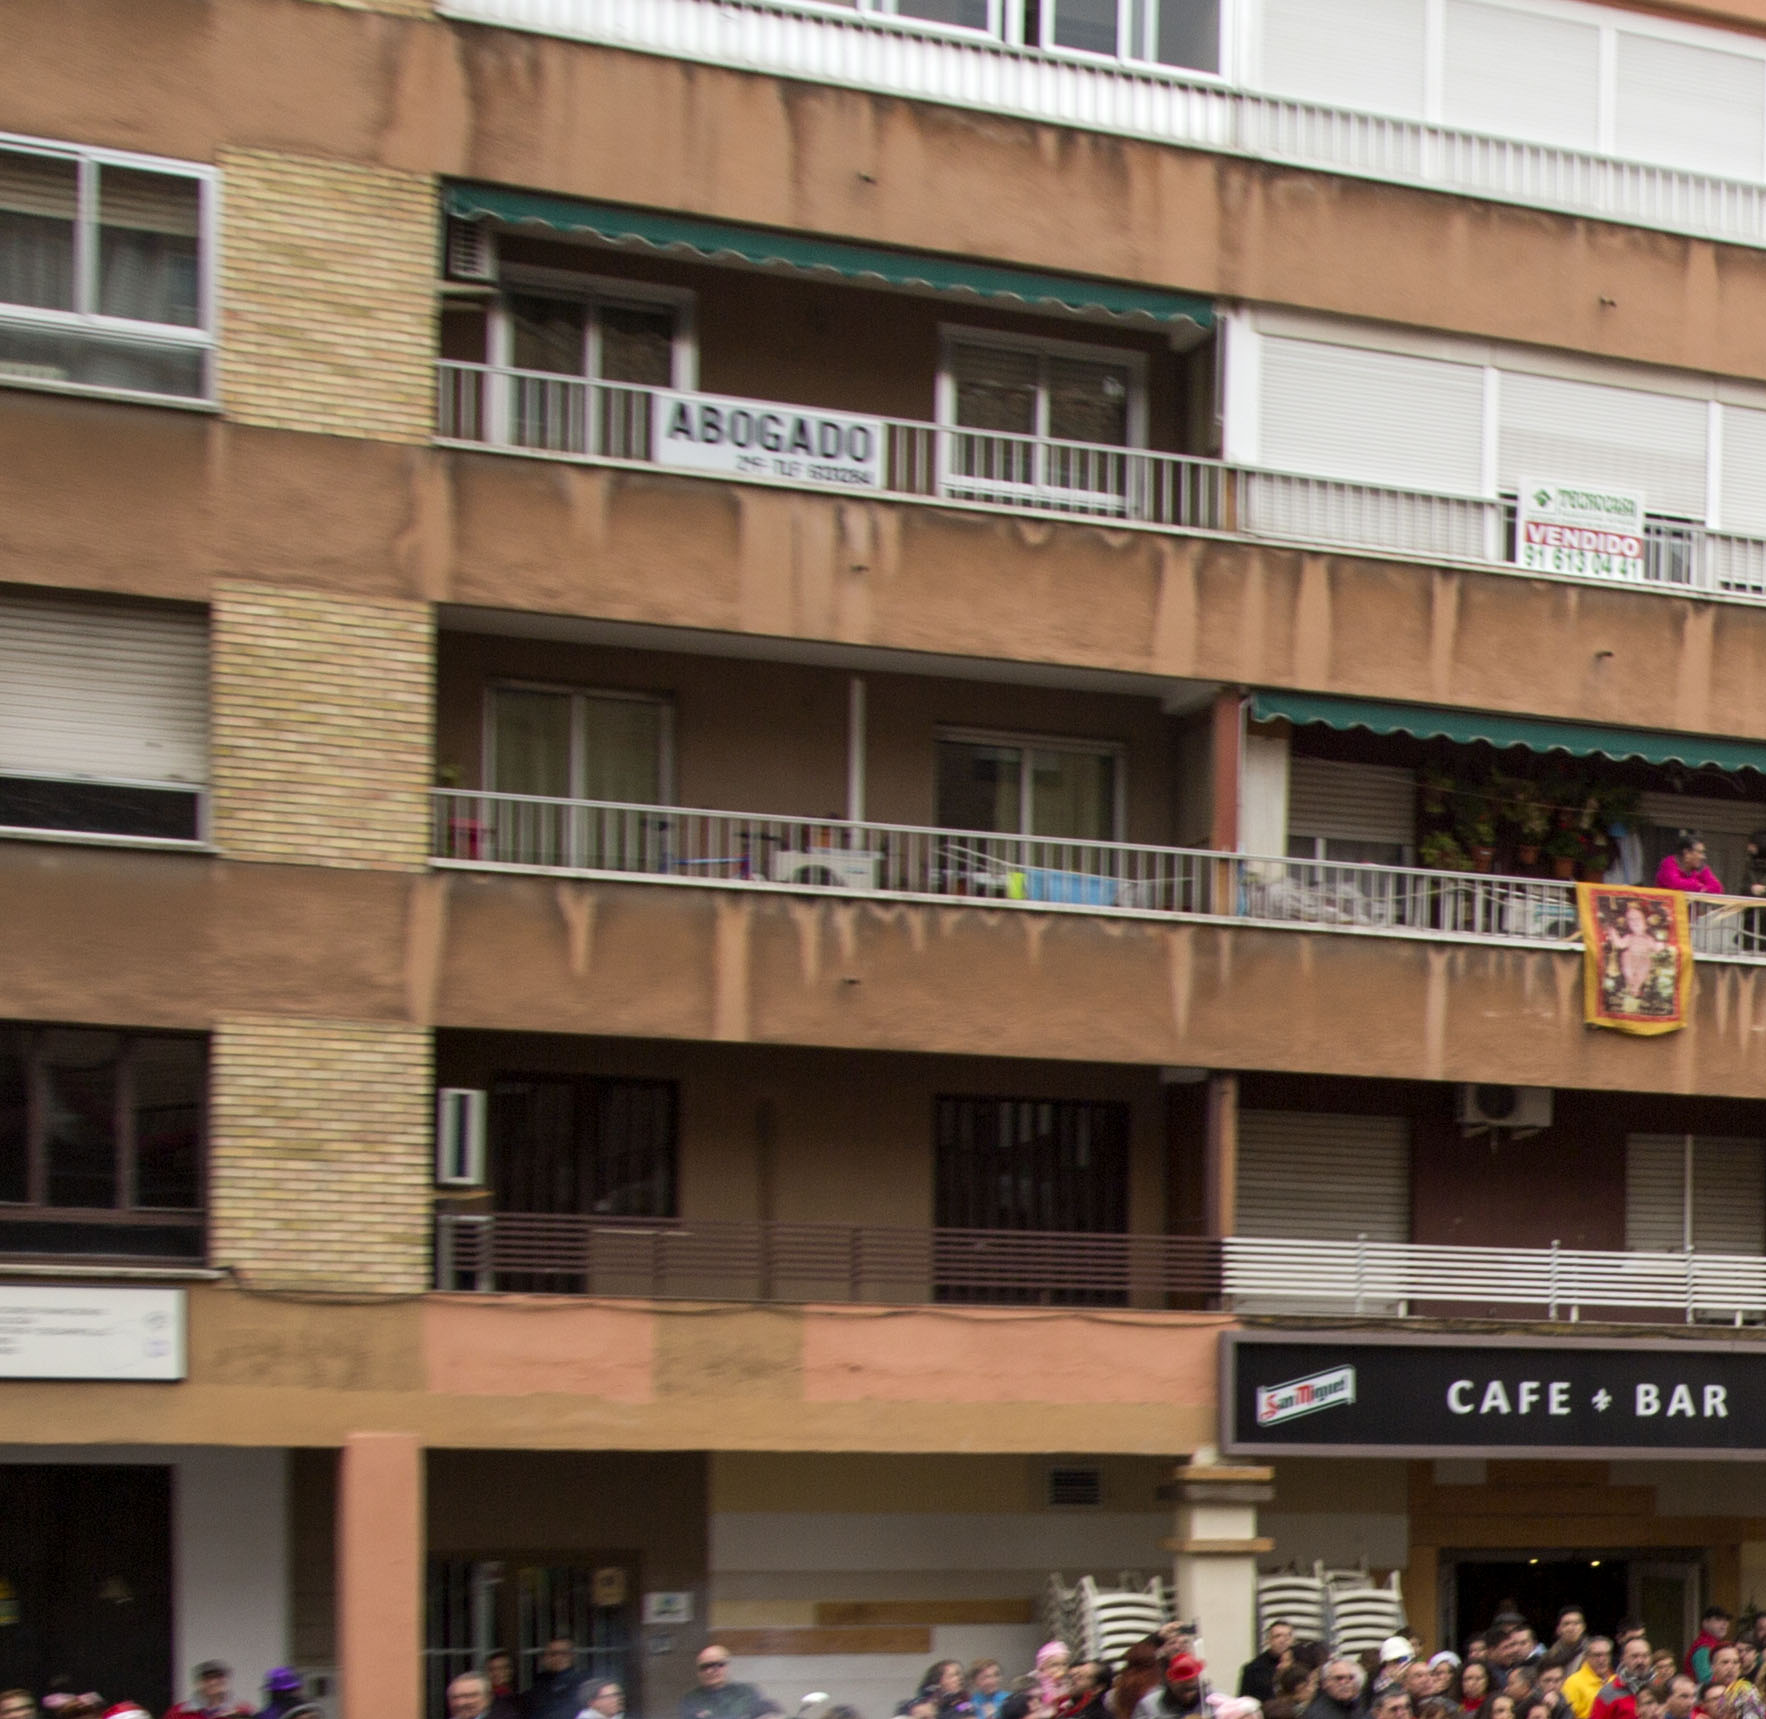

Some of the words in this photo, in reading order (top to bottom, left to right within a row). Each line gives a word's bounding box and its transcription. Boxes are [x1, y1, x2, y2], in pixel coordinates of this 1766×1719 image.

[667, 402, 873, 463] ABOGADO
[1527, 522, 1640, 558] VENDIDO
[1446, 1379, 1572, 1415] CAFE
[1635, 1383, 1729, 1418] BAR
